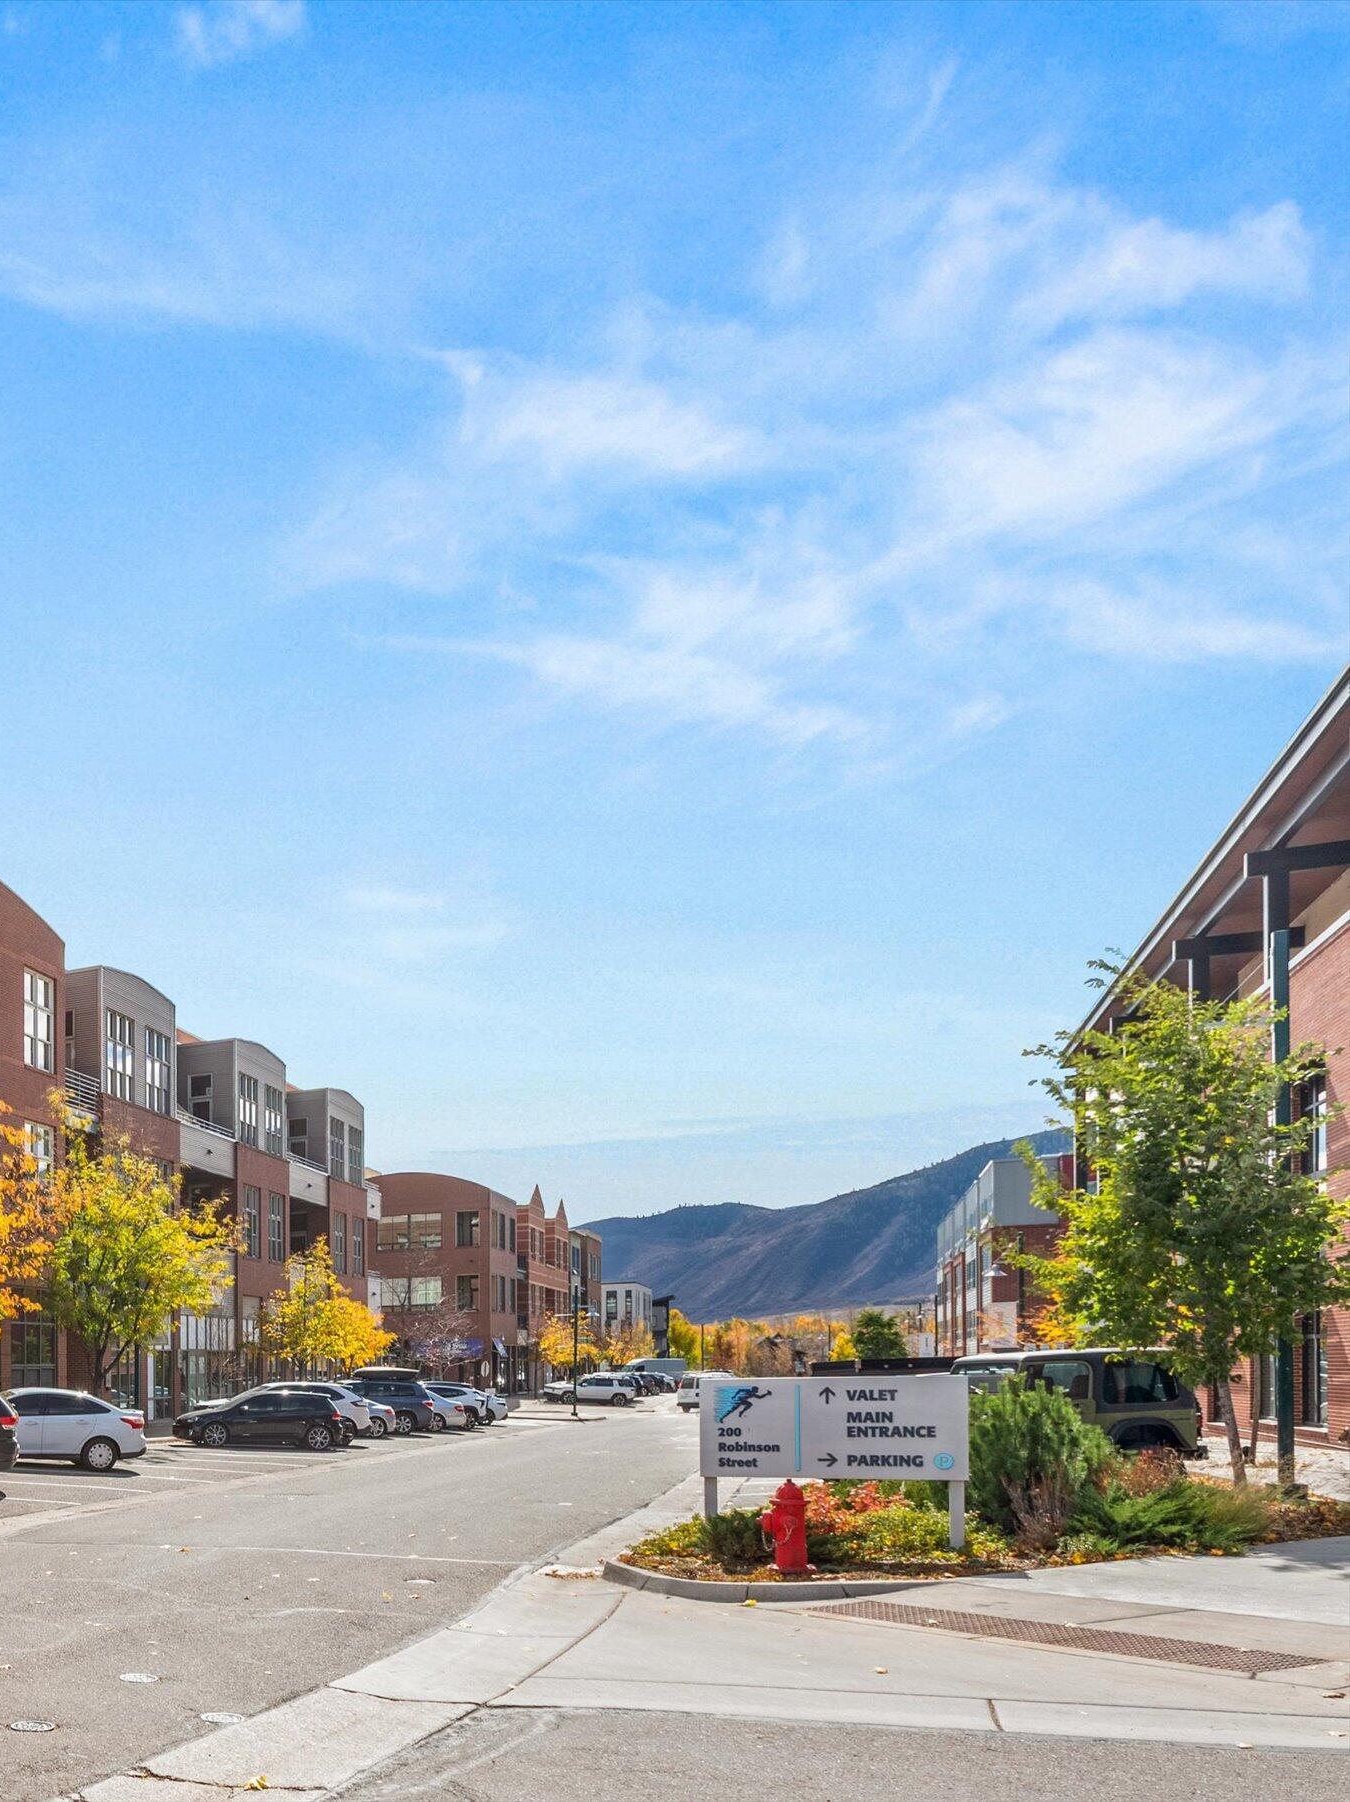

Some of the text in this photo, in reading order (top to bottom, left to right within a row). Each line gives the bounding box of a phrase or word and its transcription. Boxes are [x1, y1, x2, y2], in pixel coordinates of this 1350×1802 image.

[846, 1389, 898, 1401] VALET
[846, 1411, 894, 1423] MAIN
[717, 1427, 742, 1437] 200
[846, 1426, 937, 1438] ENTRANCE
[718, 1442, 781, 1453] Robinson
[718, 1457, 758, 1468] Street
[846, 1455, 924, 1467] PARKING
